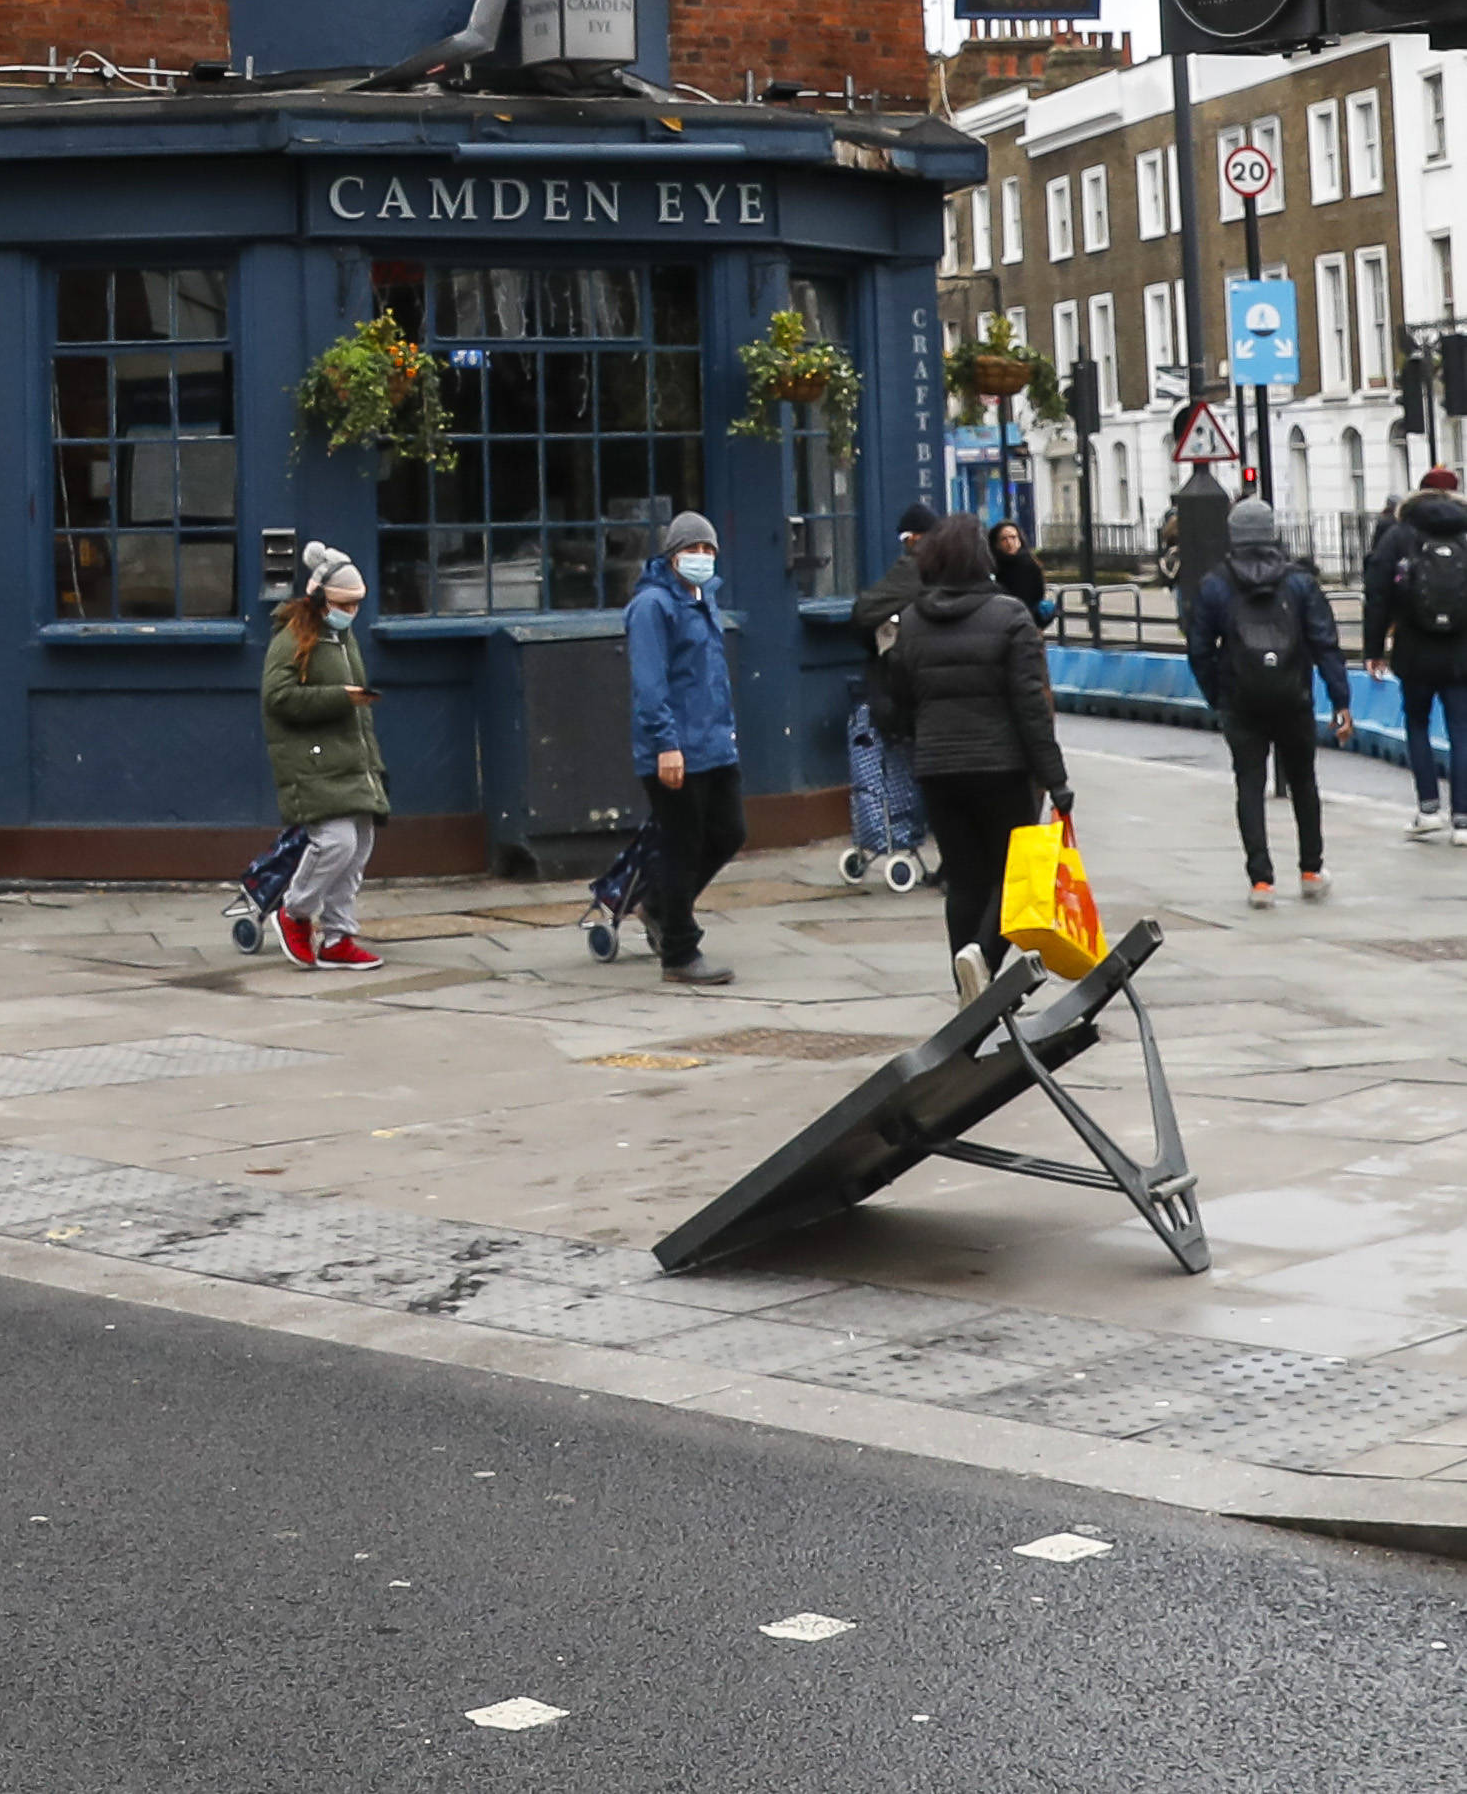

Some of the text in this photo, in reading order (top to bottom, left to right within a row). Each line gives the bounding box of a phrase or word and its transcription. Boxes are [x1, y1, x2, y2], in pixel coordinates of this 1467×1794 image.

[588, 19, 611, 34] EYE
[1232, 161, 1264, 182] 20
[328, 175, 765, 224] CAMDEN EYE
[912, 308, 931, 431] CRAFT
